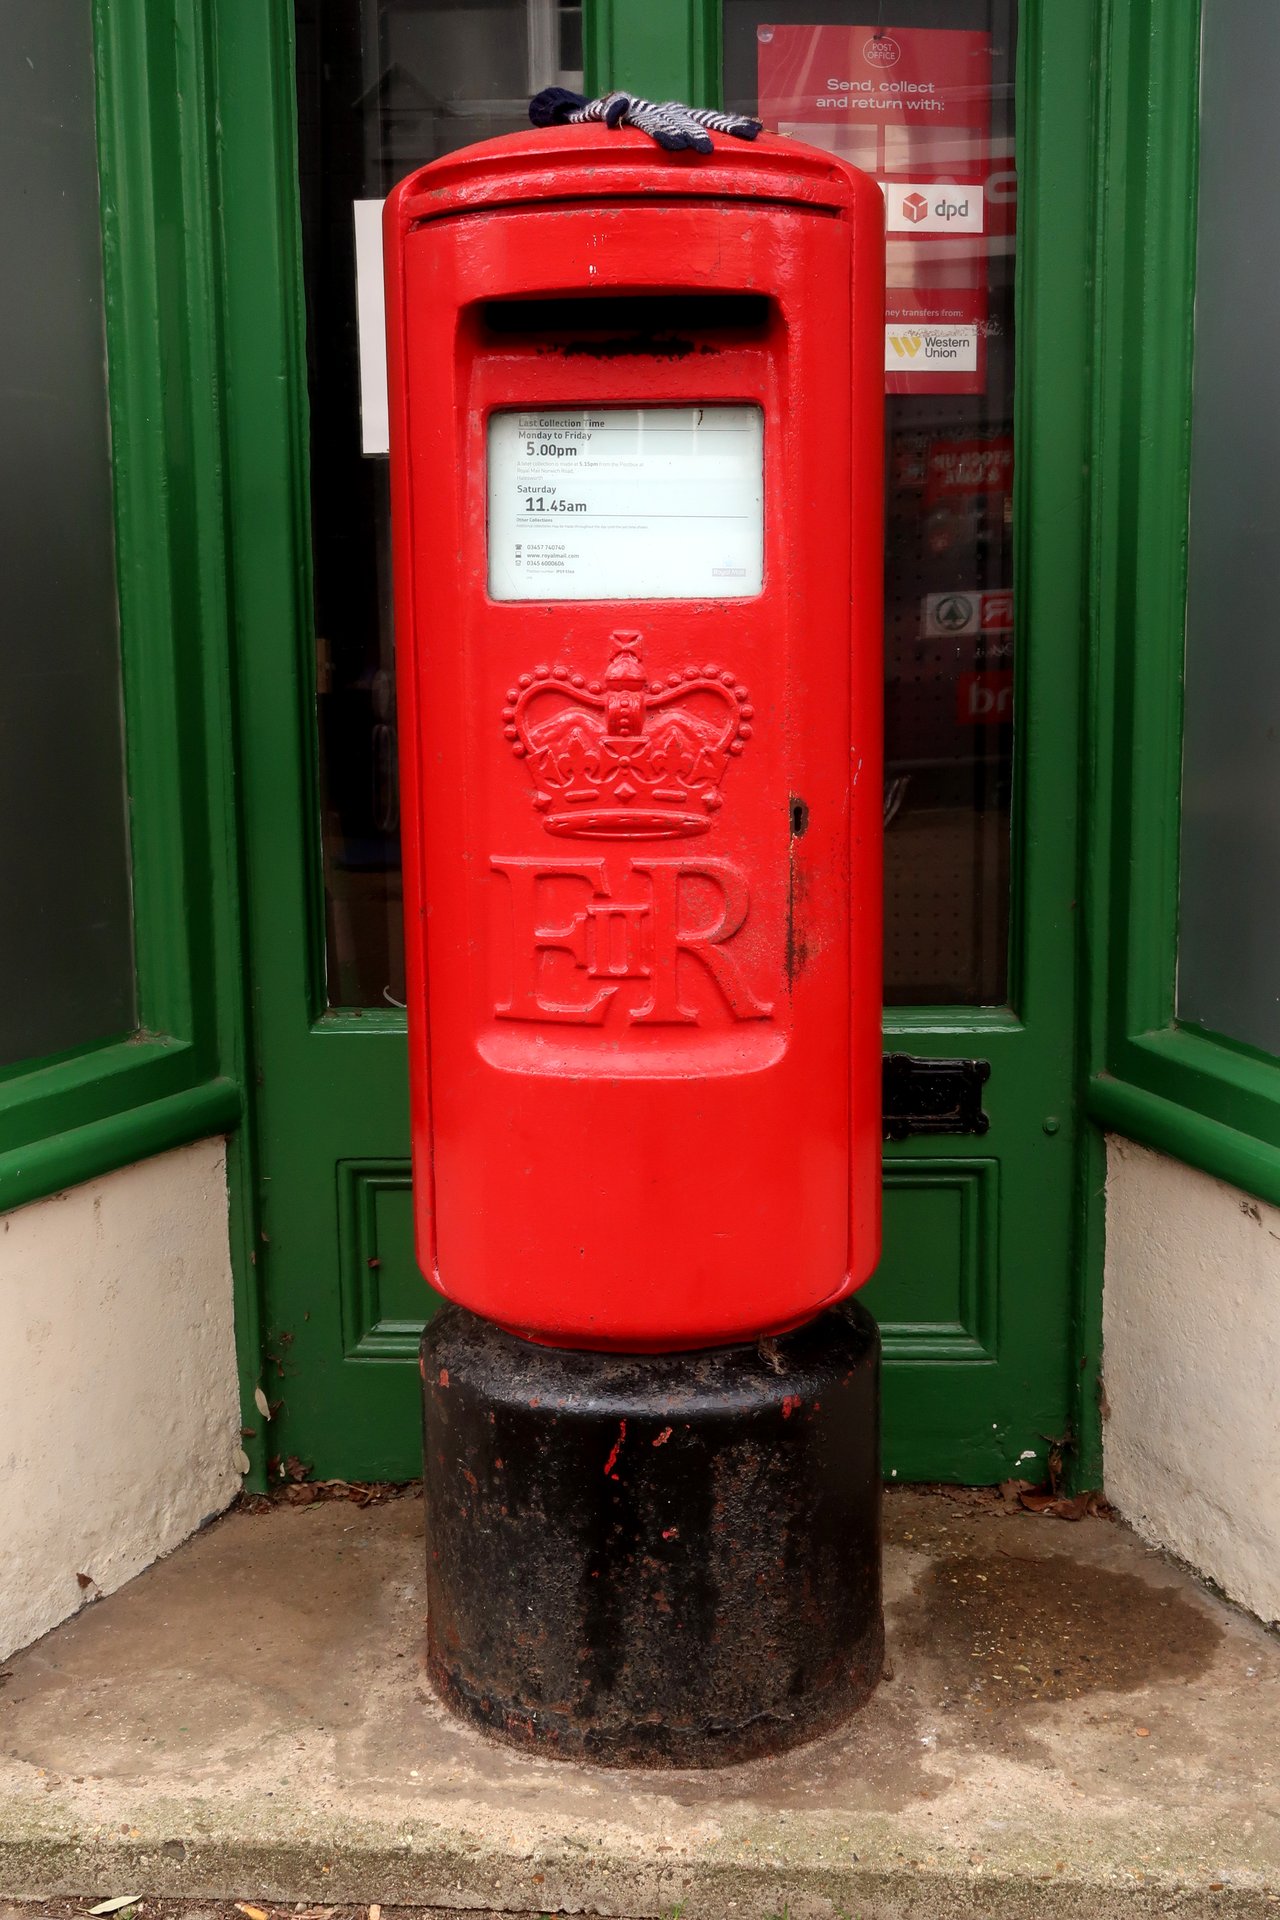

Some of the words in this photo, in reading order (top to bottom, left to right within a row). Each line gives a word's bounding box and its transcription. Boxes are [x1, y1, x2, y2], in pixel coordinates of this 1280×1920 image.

[872, 43, 892, 52] POST
[867, 51, 896, 60] OFFICE
[827, 79, 875, 93] Send,
[880, 81, 934, 93] collect
[816, 97, 848, 108] and
[852, 98, 902, 109] return
[908, 98, 944, 111] with:
[935, 200, 968, 221] dpd
[902, 308, 938, 317] transfers
[940, 308, 964, 317] from:
[925, 337, 970, 348] Western
[925, 347, 957, 358] Union
[518, 419, 538, 427] Last
[539, 419, 581, 428] Collection
[583, 419, 605, 428] Time
[518, 431, 552, 441] Monday
[565, 432, 592, 441] Friday
[526, 442, 577, 458] 5.00pm
[517, 485, 556, 495] Saturday
[525, 497, 587, 512] 11.45am
